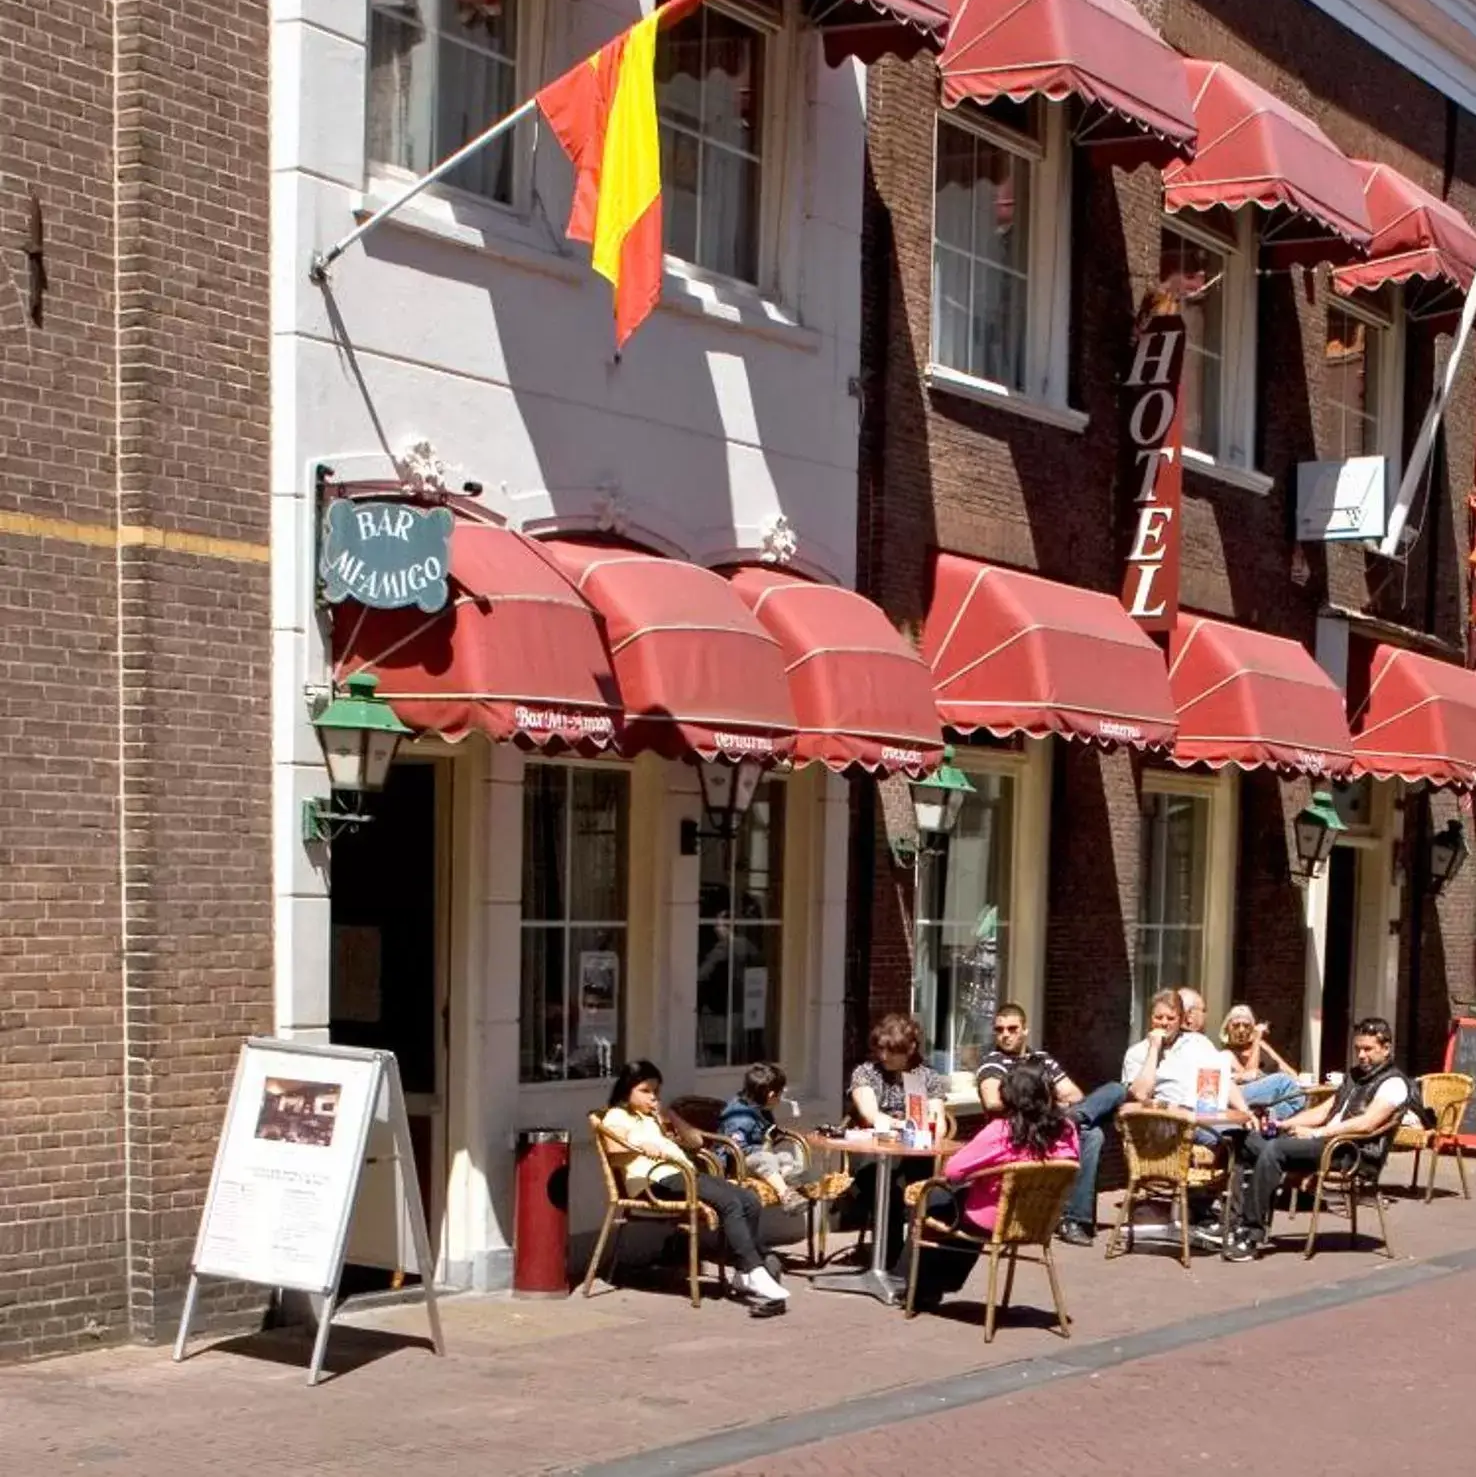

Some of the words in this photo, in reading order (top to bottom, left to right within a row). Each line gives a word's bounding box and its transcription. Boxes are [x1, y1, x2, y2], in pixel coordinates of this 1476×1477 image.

[1123, 330, 1182, 617] HOTEL
[355, 508, 415, 542] BAR
[331, 549, 442, 600] MI-AMIGO
